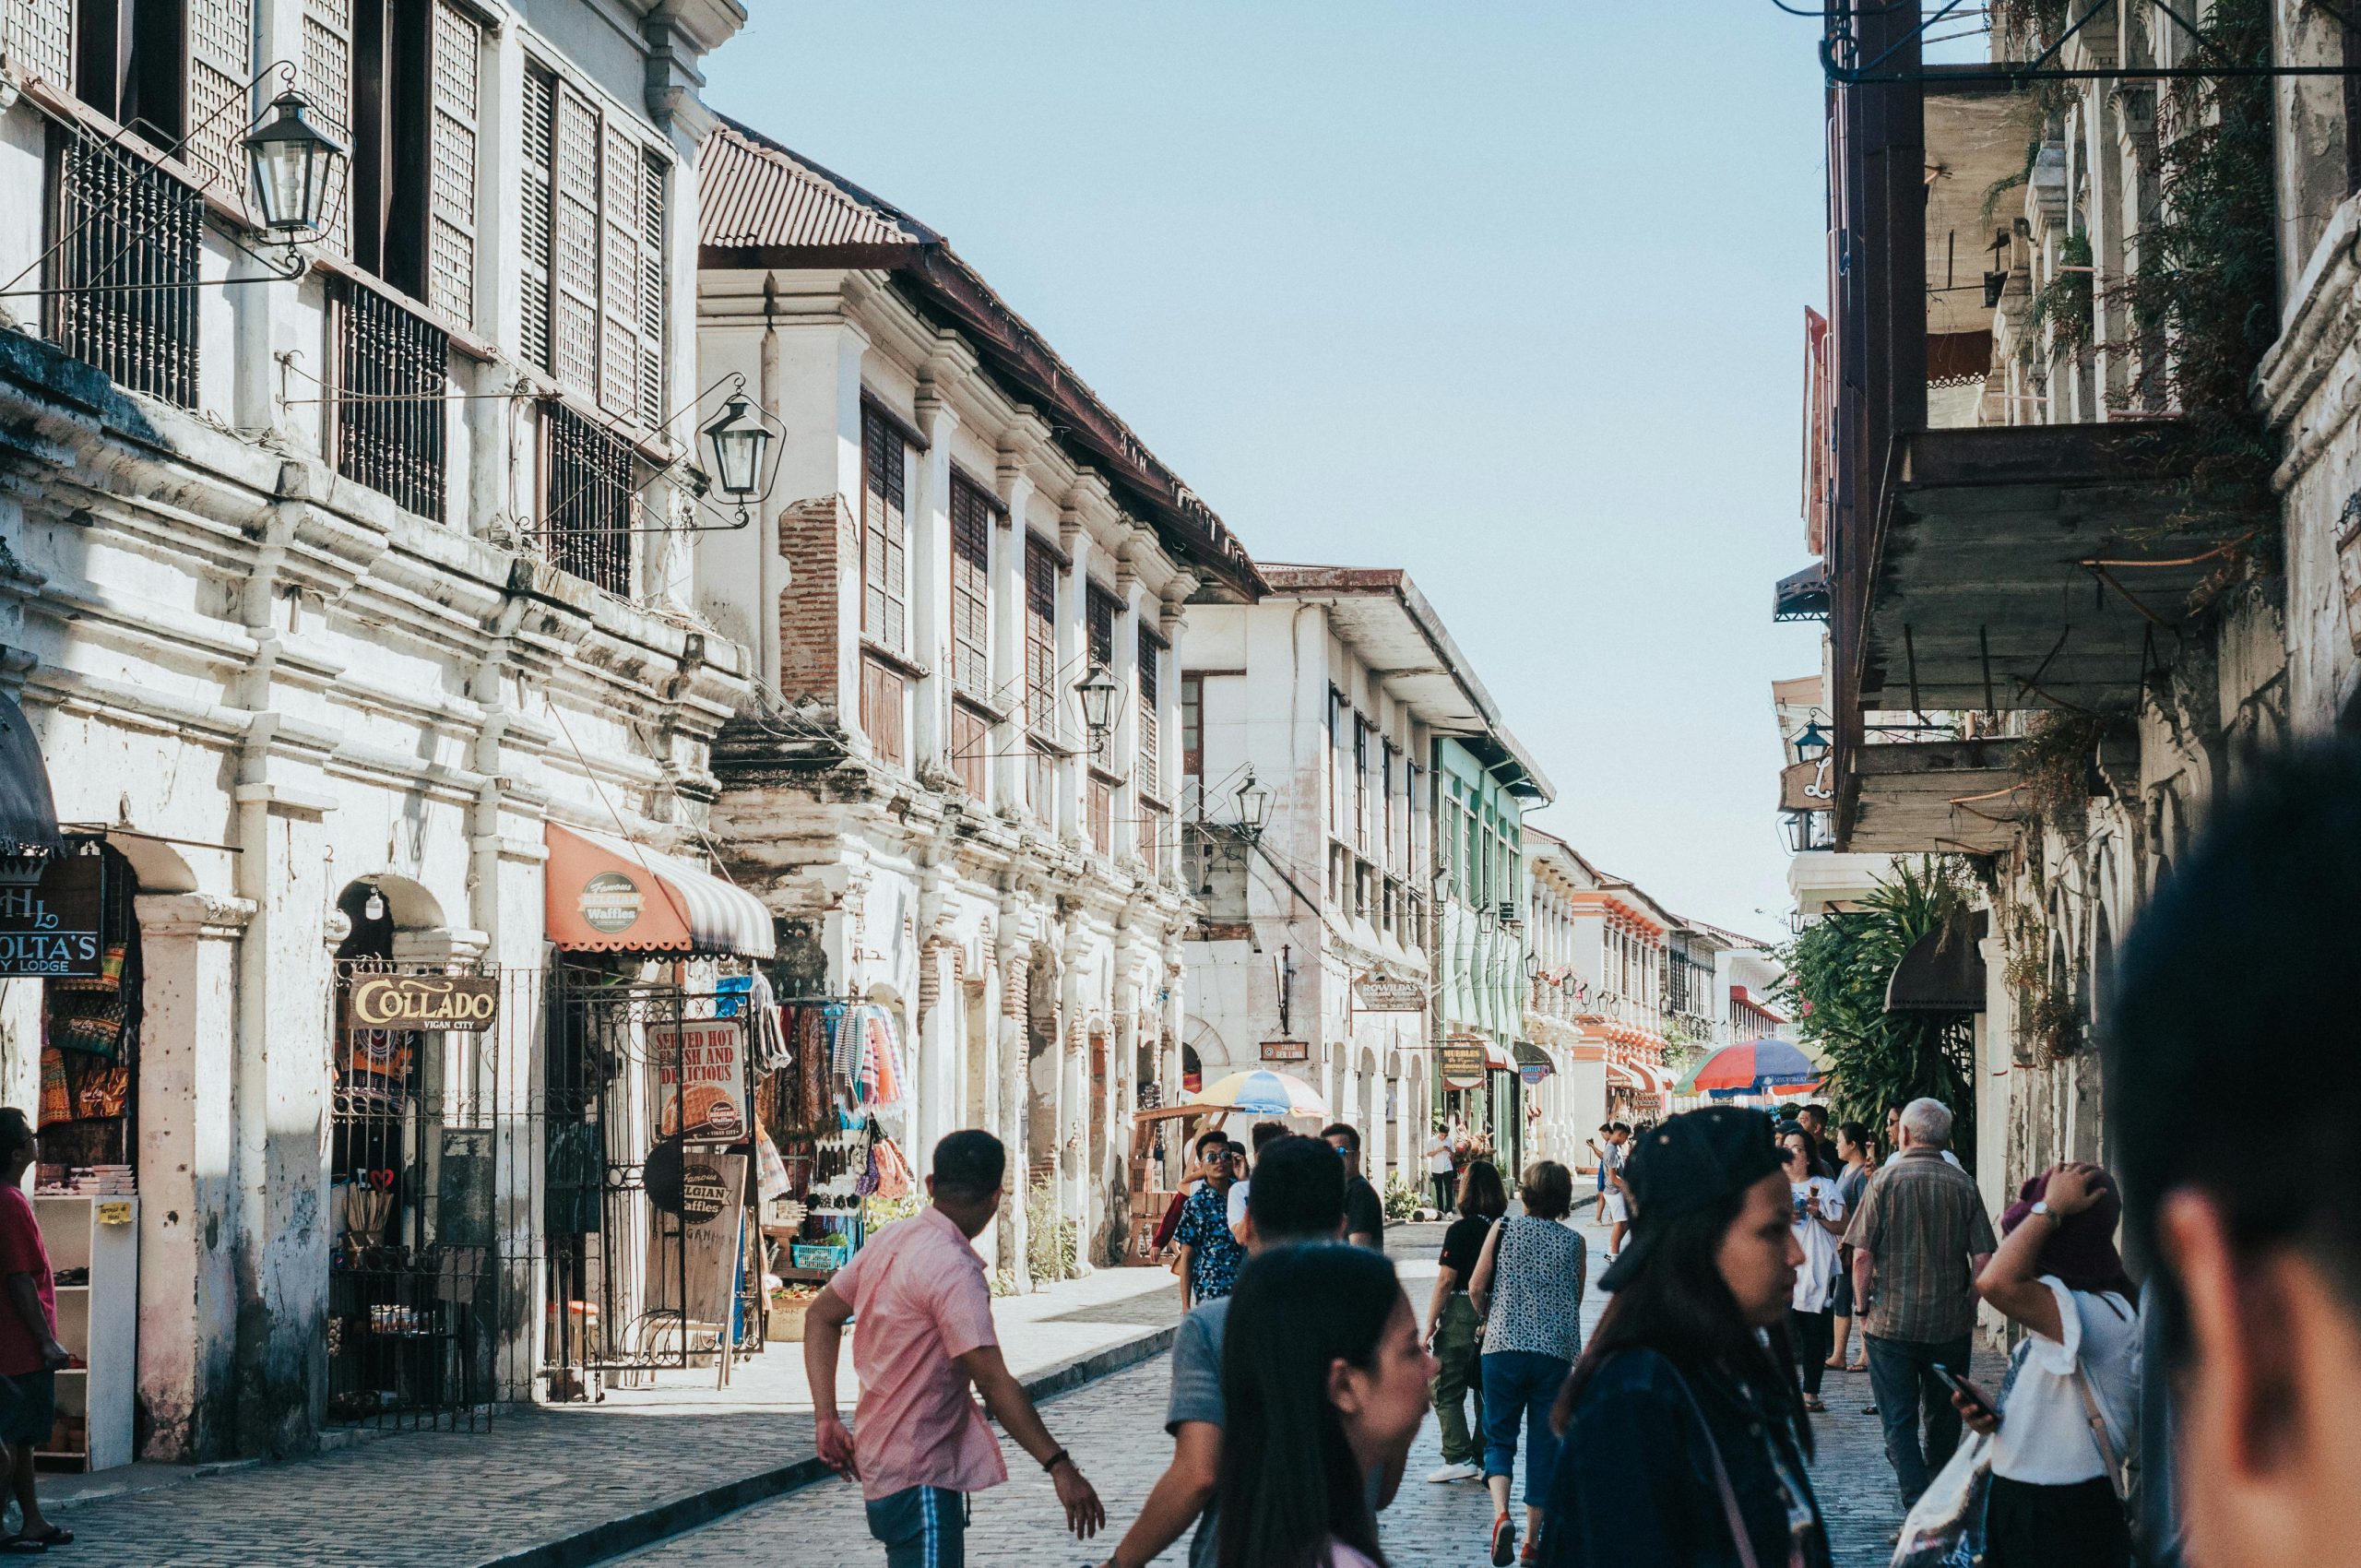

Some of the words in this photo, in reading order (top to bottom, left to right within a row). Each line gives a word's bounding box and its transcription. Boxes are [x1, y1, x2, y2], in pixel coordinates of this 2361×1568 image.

[587, 908, 635, 920] Waffles
[20, 960, 69, 972] LODGE
[424, 1020, 450, 1028] VIGAN
[454, 1021, 474, 1029] CITY
[707, 1029, 734, 1047] HOT
[706, 1047, 734, 1063] AND
[683, 1200, 718, 1213] affles
